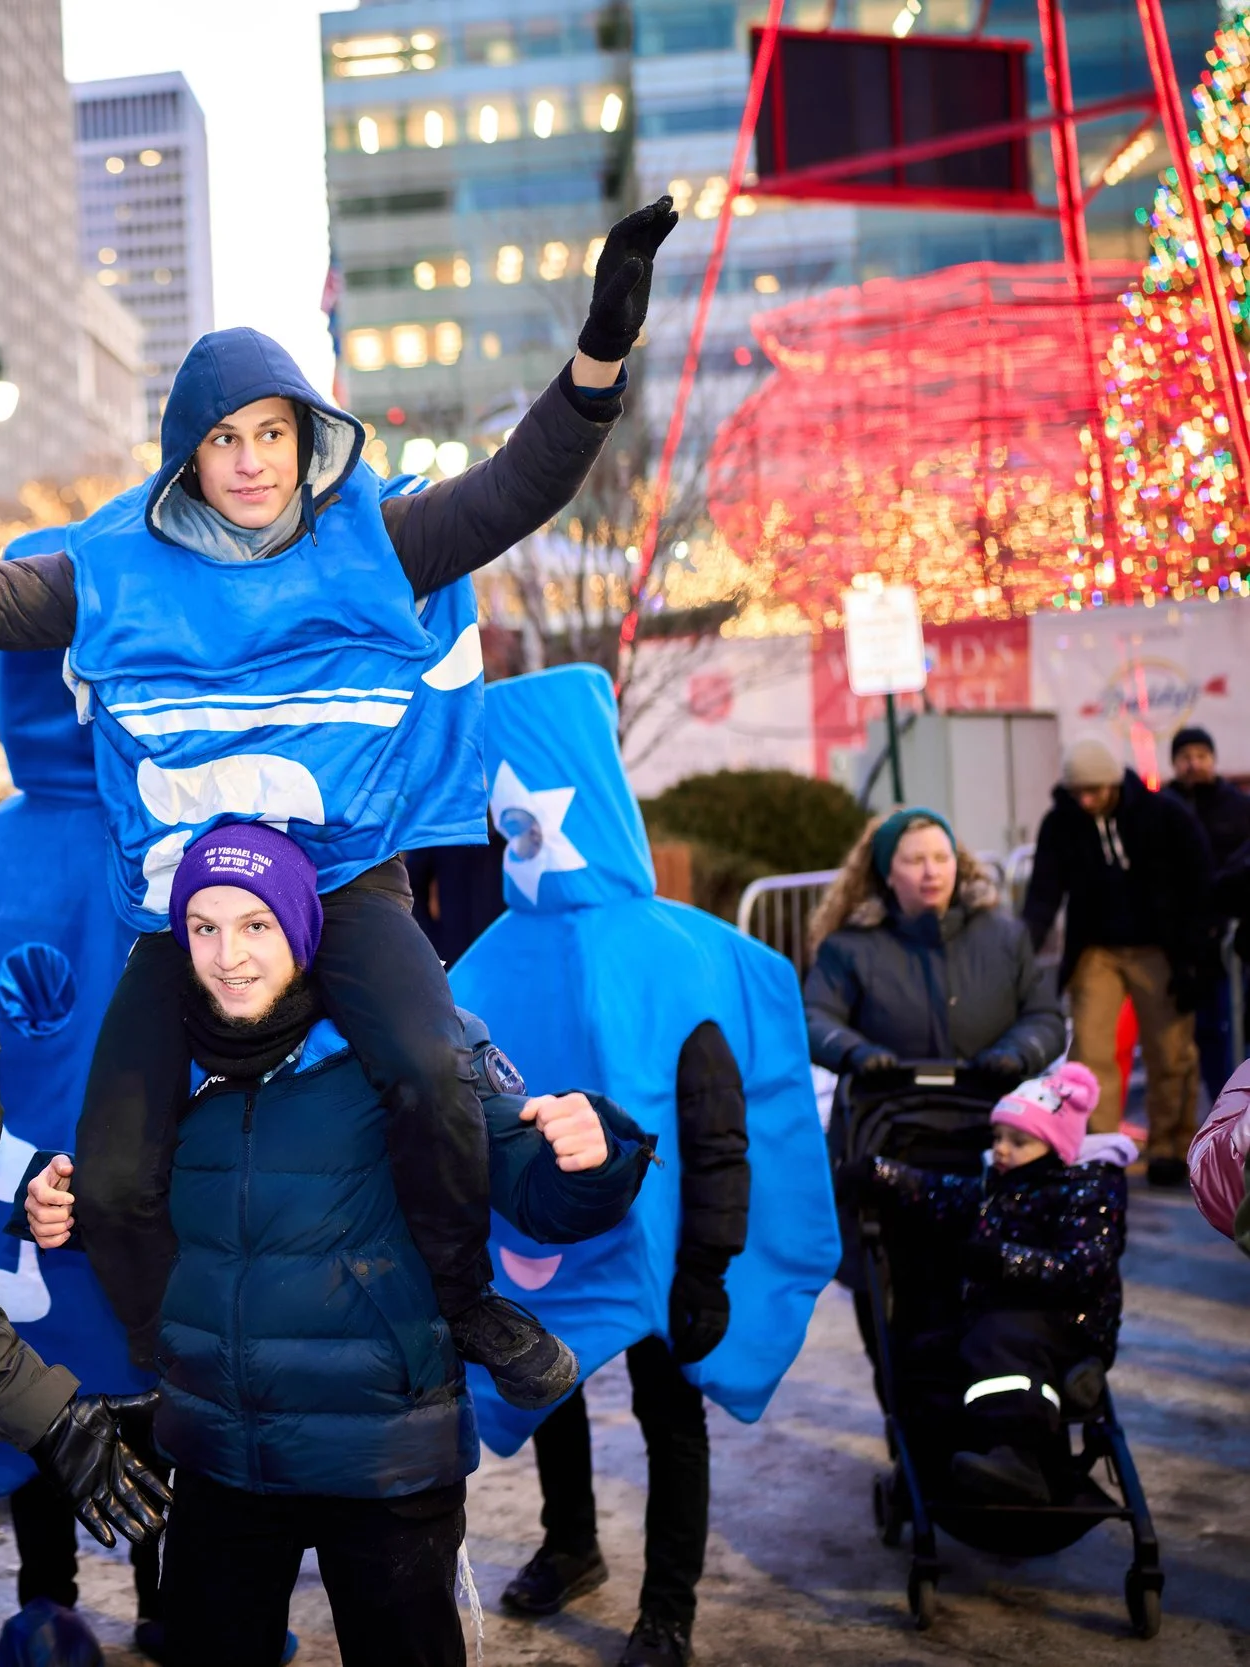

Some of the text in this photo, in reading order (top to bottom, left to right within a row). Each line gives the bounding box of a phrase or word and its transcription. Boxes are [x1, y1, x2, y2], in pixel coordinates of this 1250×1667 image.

[204, 847, 273, 867] AM YISRAEL CHAI
[207, 856, 265, 874] עם ישראל חי
